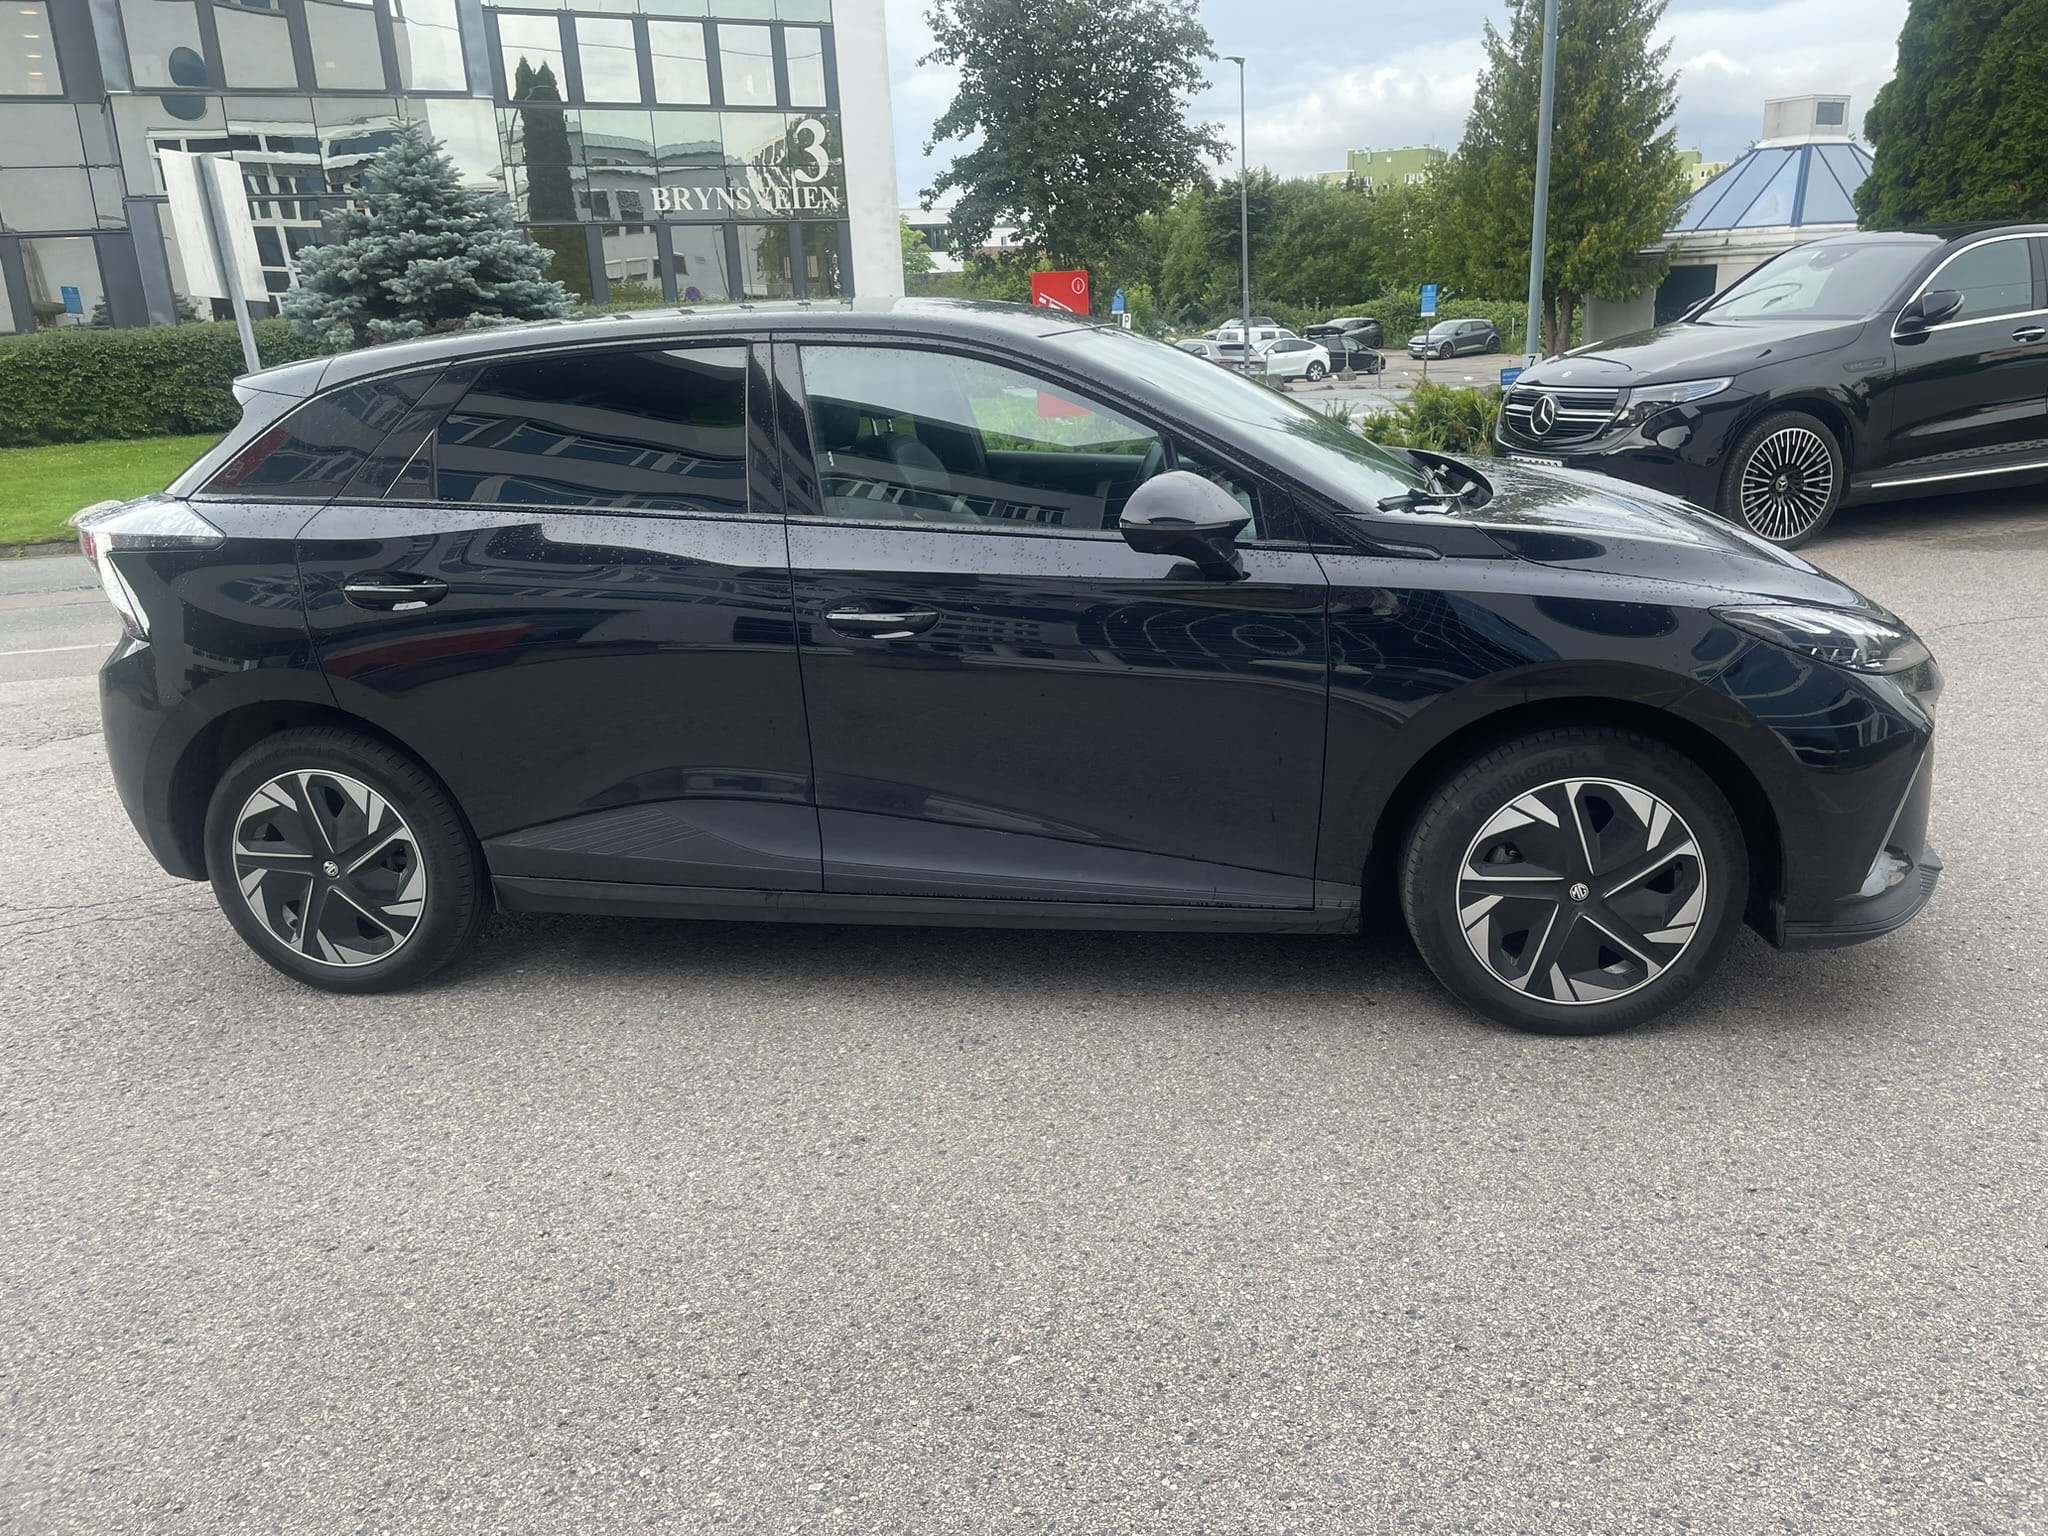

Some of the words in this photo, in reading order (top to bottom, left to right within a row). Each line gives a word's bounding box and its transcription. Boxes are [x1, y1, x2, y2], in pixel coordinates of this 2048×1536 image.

[795, 118, 829, 183] 3
[651, 186, 839, 211] BRYNSVEIEN
[1528, 355, 1536, 367] 7
[1571, 884, 1588, 899] MG
